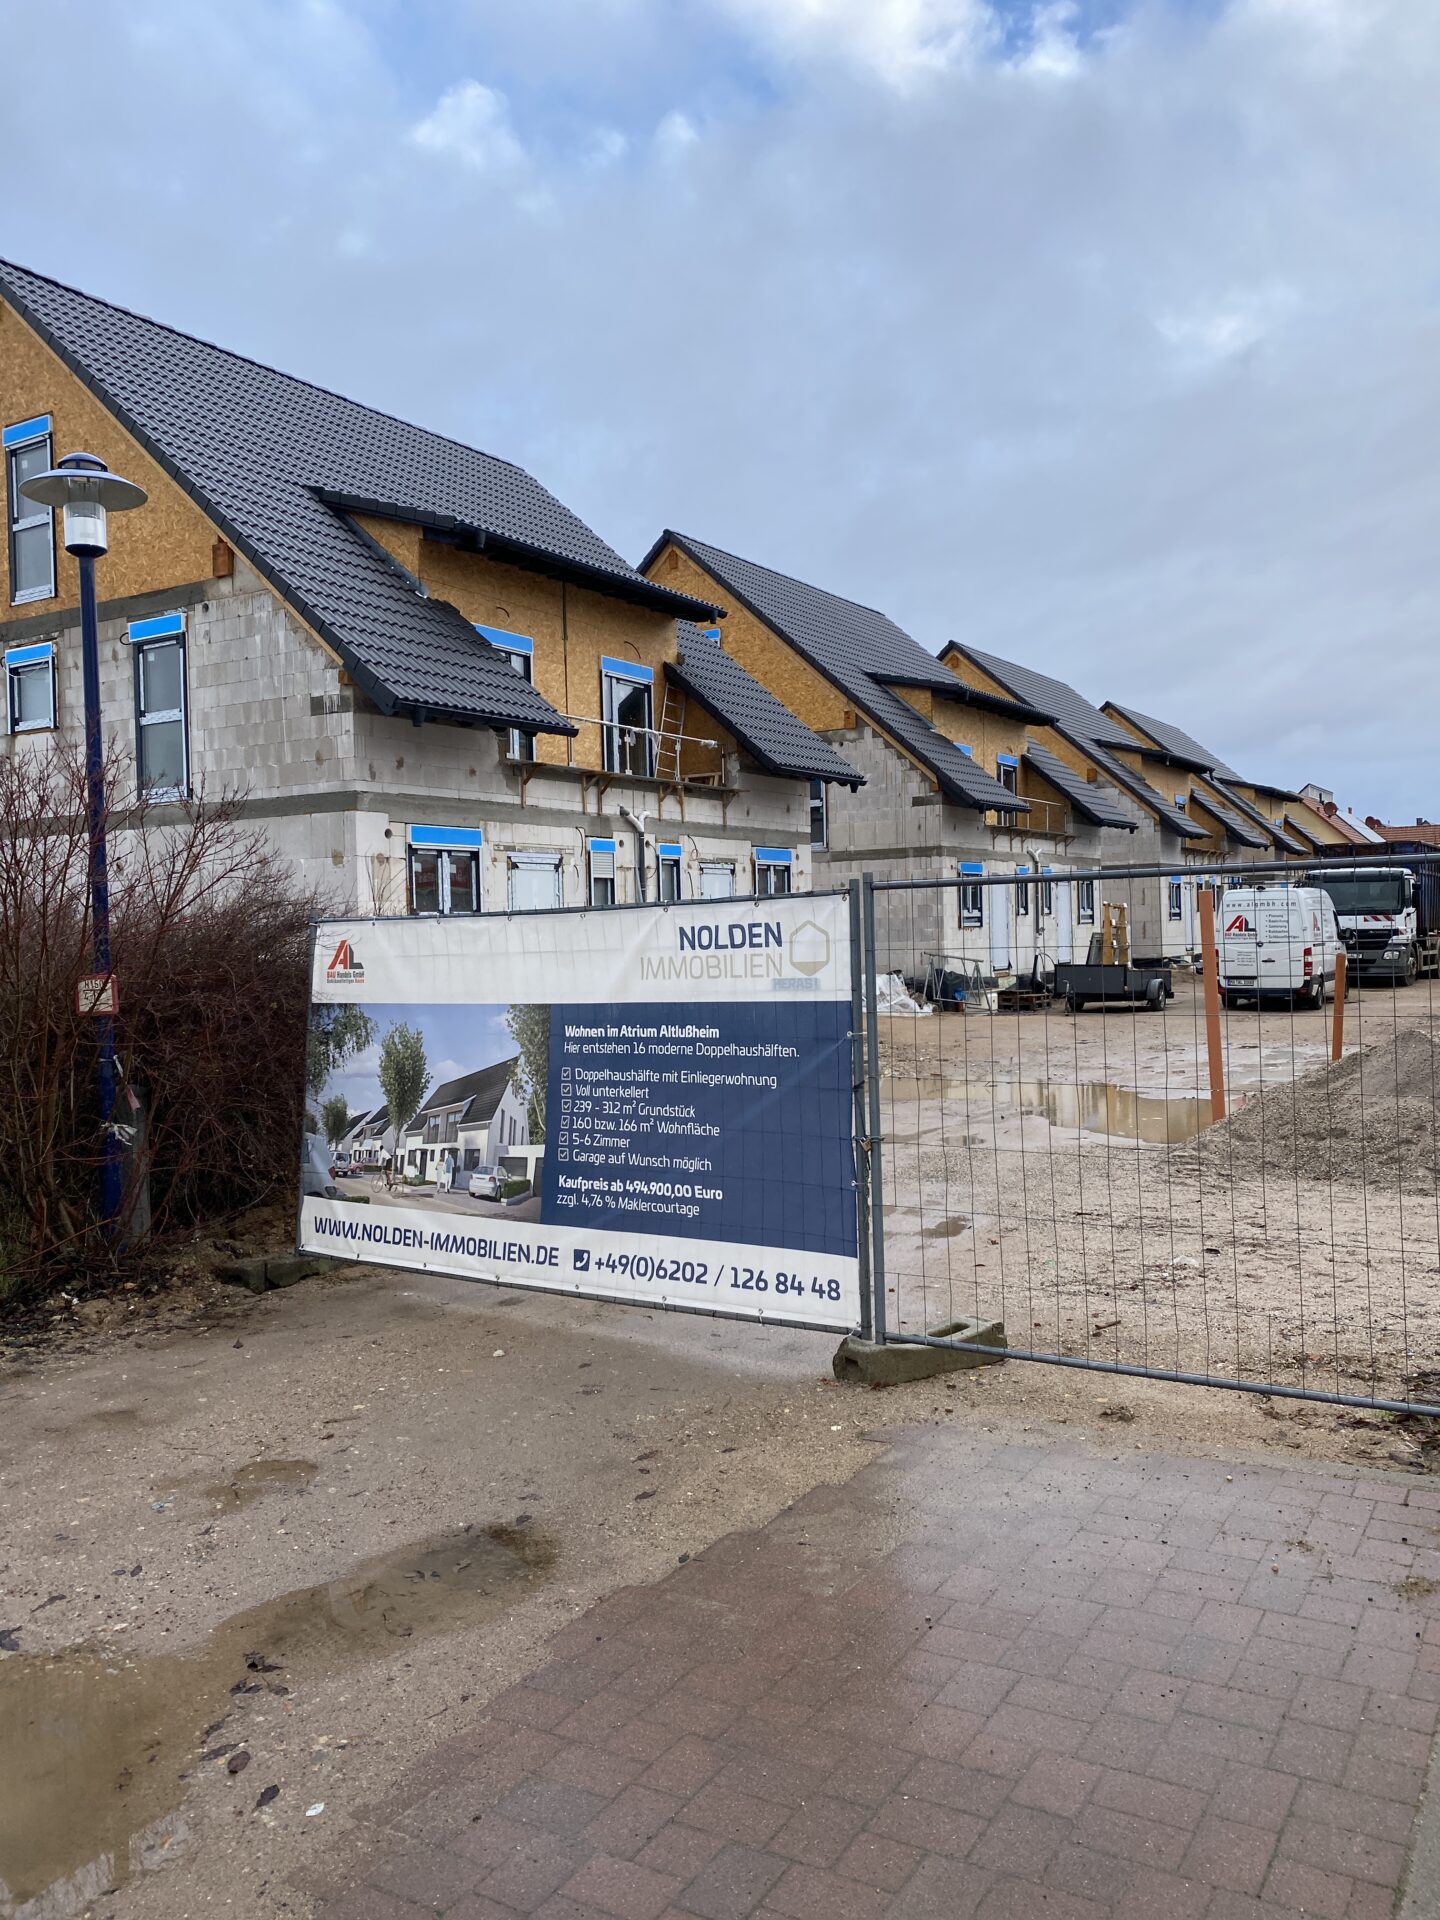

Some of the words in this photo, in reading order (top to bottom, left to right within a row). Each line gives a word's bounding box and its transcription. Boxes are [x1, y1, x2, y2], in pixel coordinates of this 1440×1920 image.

[679, 922, 783, 951] NOLDEN
[640, 953, 783, 980] IMMOBILIEN
[564, 1025, 605, 1037] Wohnen
[607, 1025, 618, 1037] im
[620, 1025, 657, 1038] Atrium
[659, 1025, 719, 1038] Altlußheim
[564, 1041, 580, 1053] Hier
[582, 1042, 631, 1054] entstehen
[633, 1042, 645, 1054] 16
[648, 1043, 693, 1055] moderne
[696, 1043, 800, 1058] Doppelhaushälften.
[575, 1068, 660, 1083] Doppelhaushälfte
[662, 1070, 678, 1083] mit
[681, 1071, 777, 1089] Einliegerwohnung
[575, 1084, 591, 1097] Voll
[592, 1086, 649, 1098] unterkellert
[573, 1101, 592, 1113] 239
[602, 1101, 620, 1114] 312
[638, 1103, 696, 1118] Grundstück
[572, 1117, 591, 1129] 160
[594, 1118, 617, 1131] bzw.
[620, 1118, 637, 1132] 166
[657, 1120, 720, 1136] Wohnfläche
[572, 1133, 591, 1145] 5-6
[593, 1134, 630, 1148] Zimmer
[572, 1150, 605, 1165] Garage
[608, 1152, 626, 1165] auf
[628, 1153, 670, 1168] Wunsch
[673, 1157, 712, 1173] möglich
[558, 1175, 609, 1192] Kaufpreis
[610, 1179, 624, 1192] ab
[625, 1180, 692, 1199] 494.900,00
[694, 1185, 723, 1200] Euro
[557, 1193, 579, 1208] zzgl.
[581, 1193, 603, 1208] 4,76
[604, 1195, 616, 1208] %
[618, 1196, 700, 1218] Maklercourtage
[314, 1216, 559, 1267] WWW.NOLDEN-IMMOBILIEN.DE
[594, 1252, 708, 1285] +49(0)6202
[713, 1265, 725, 1287] /
[730, 1266, 769, 1292] 126
[775, 1272, 804, 1297] 84
[811, 1277, 841, 1301] 48
